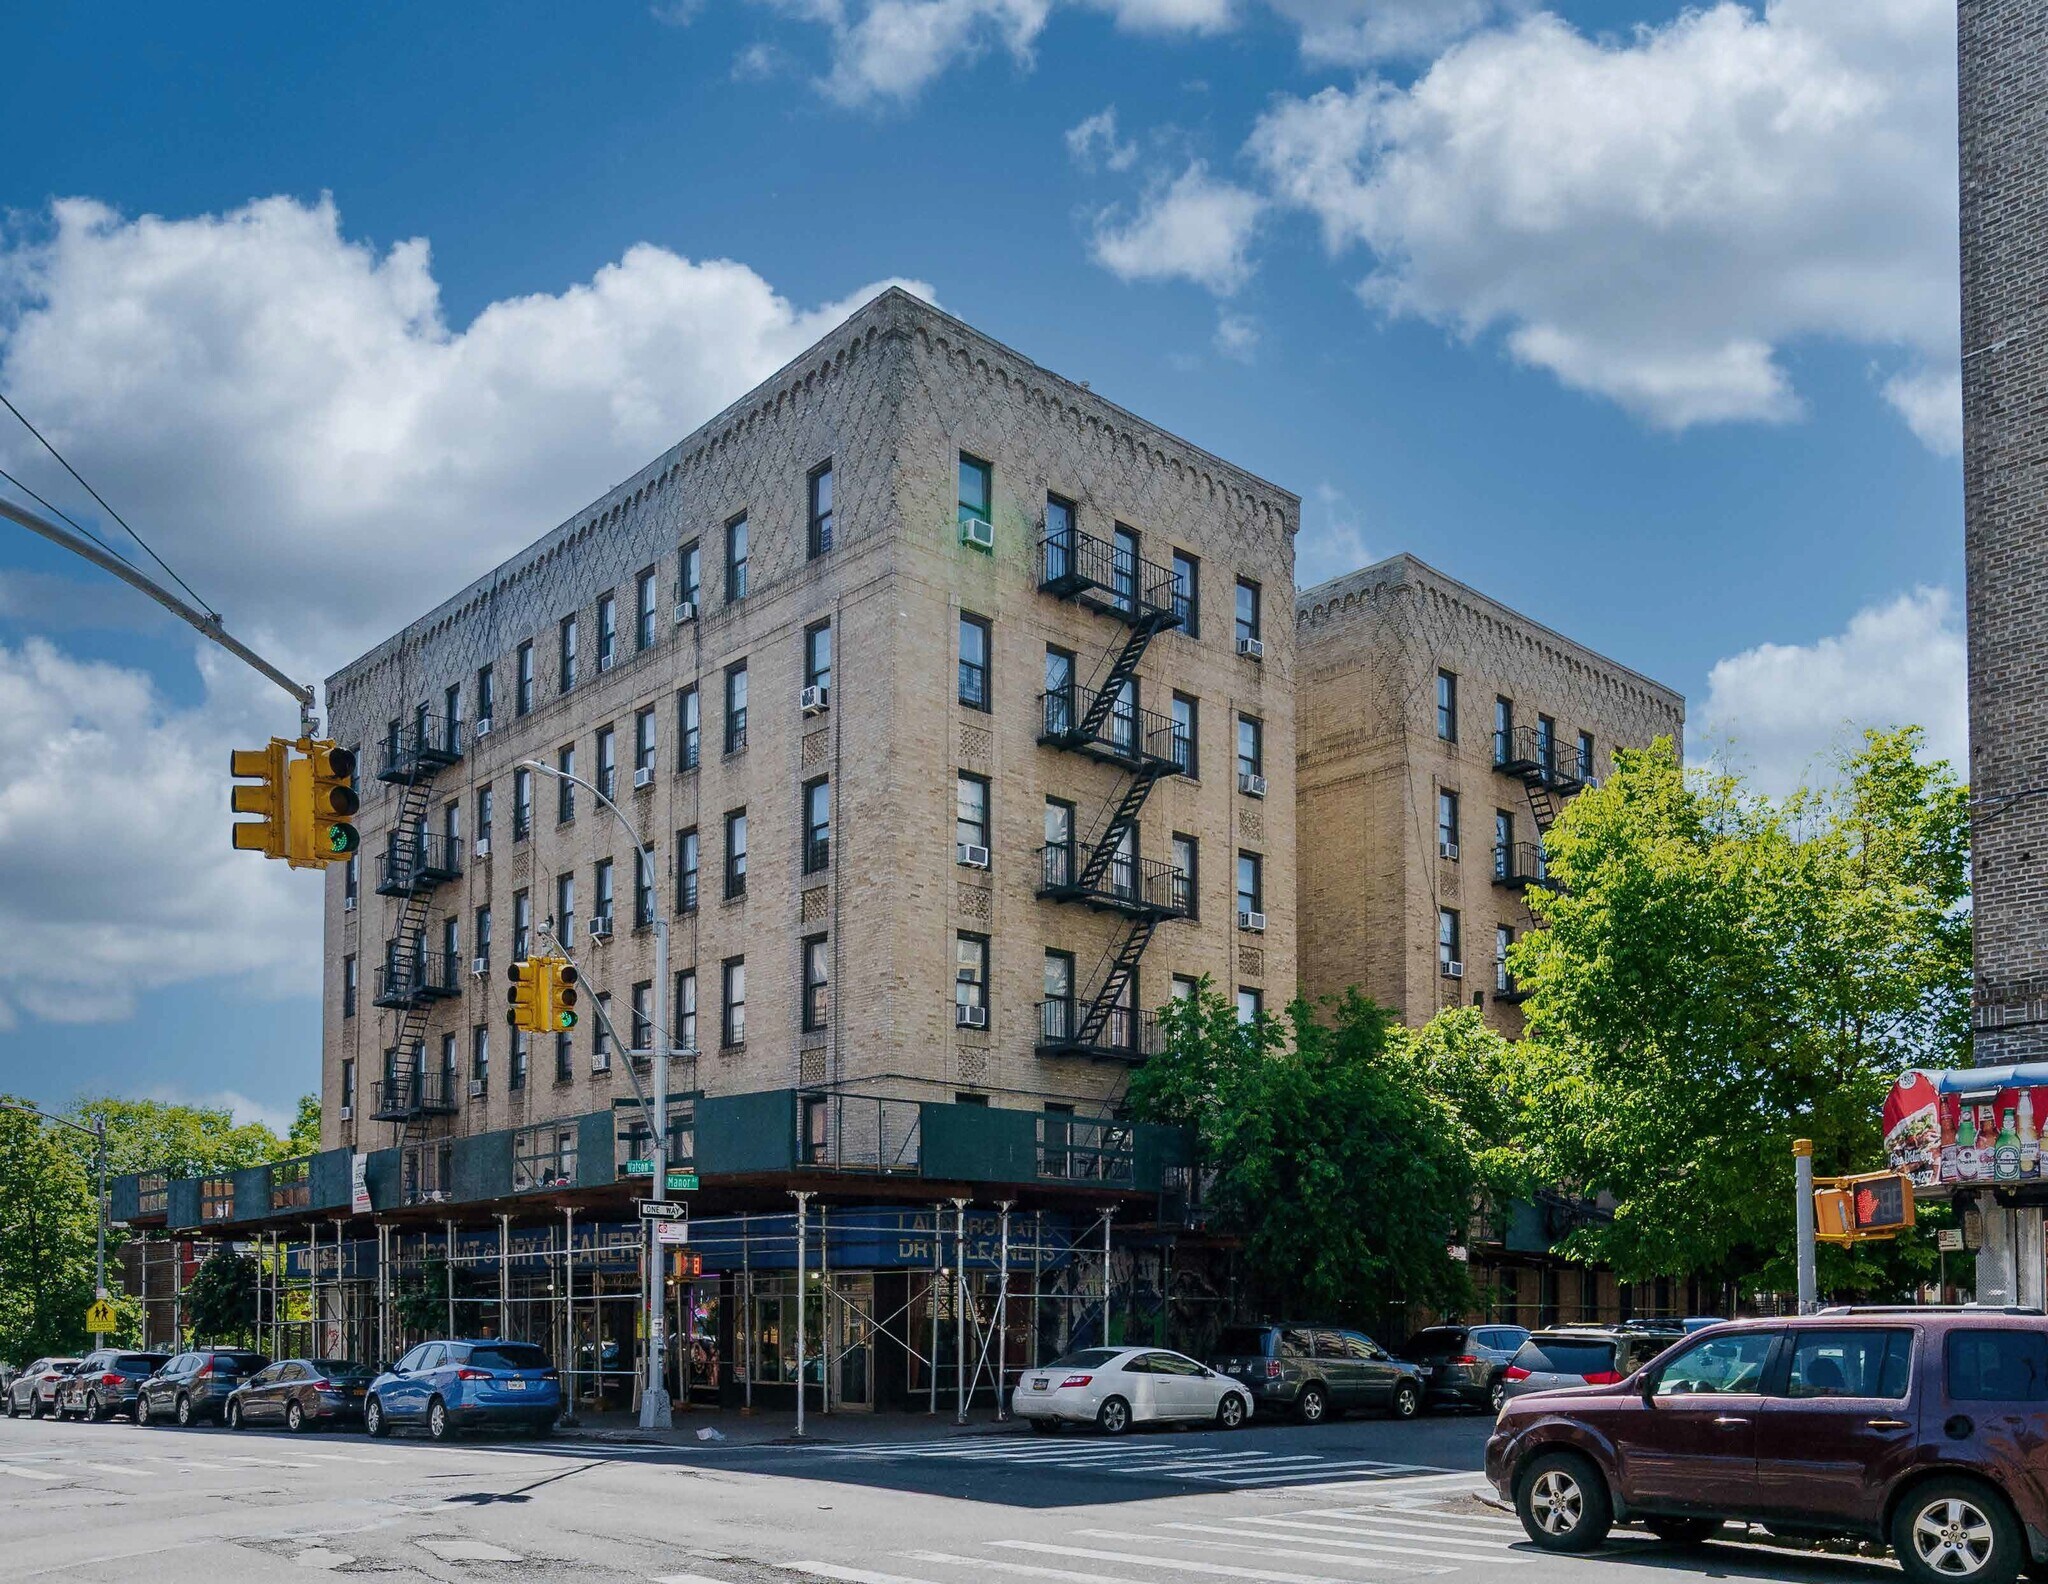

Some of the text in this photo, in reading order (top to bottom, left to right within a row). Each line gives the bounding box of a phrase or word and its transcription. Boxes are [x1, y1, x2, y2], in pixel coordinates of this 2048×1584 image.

[627, 1162, 649, 1173] Watson
[668, 1176, 691, 1188] Manor
[646, 1205, 680, 1215] ONE WAY
[386, 1240, 480, 1269] AUNDROAT
[542, 1230, 645, 1265] CEANERS
